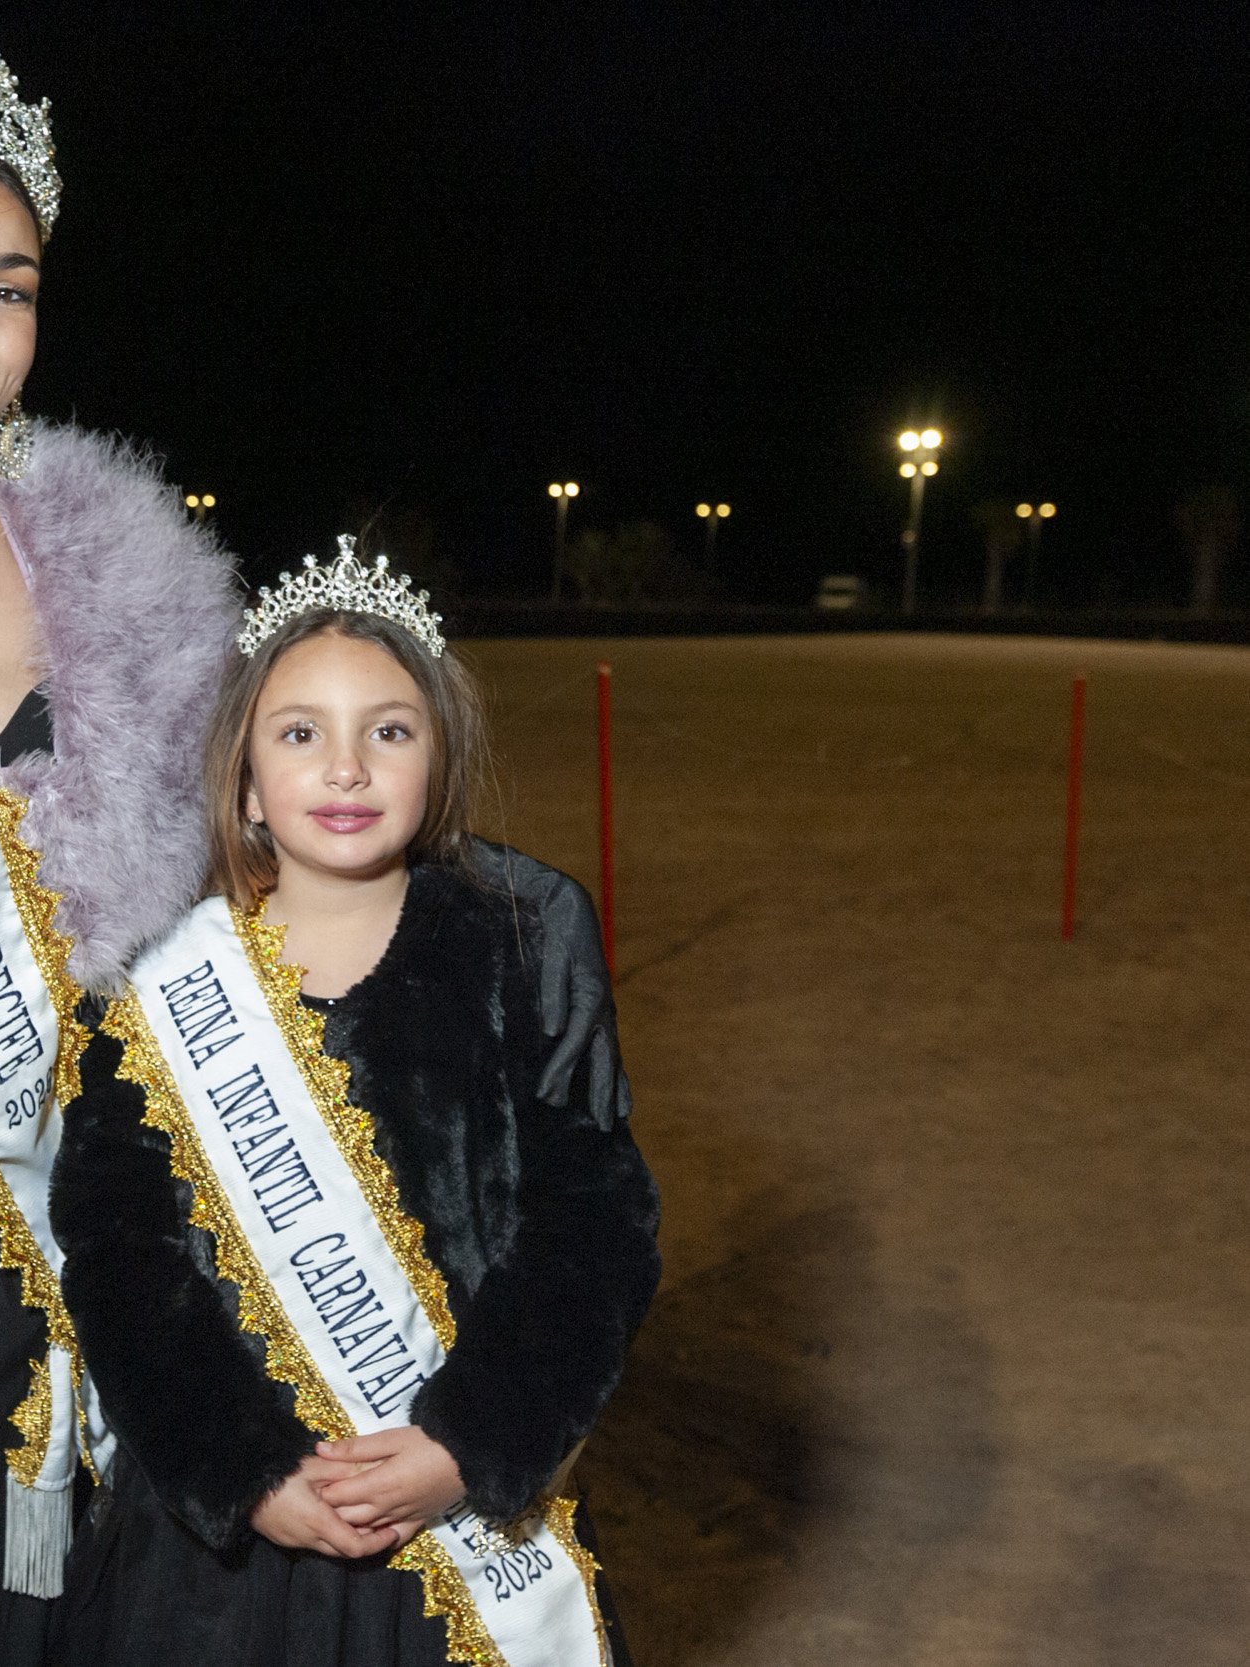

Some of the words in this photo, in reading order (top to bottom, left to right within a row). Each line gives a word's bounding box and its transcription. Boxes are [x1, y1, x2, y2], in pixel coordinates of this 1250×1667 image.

[159, 960, 245, 1070] REINA
[206, 1063, 324, 1233] INFANTIL
[290, 1232, 426, 1418] CARNAVAL
[485, 1538, 552, 1602] 2026
